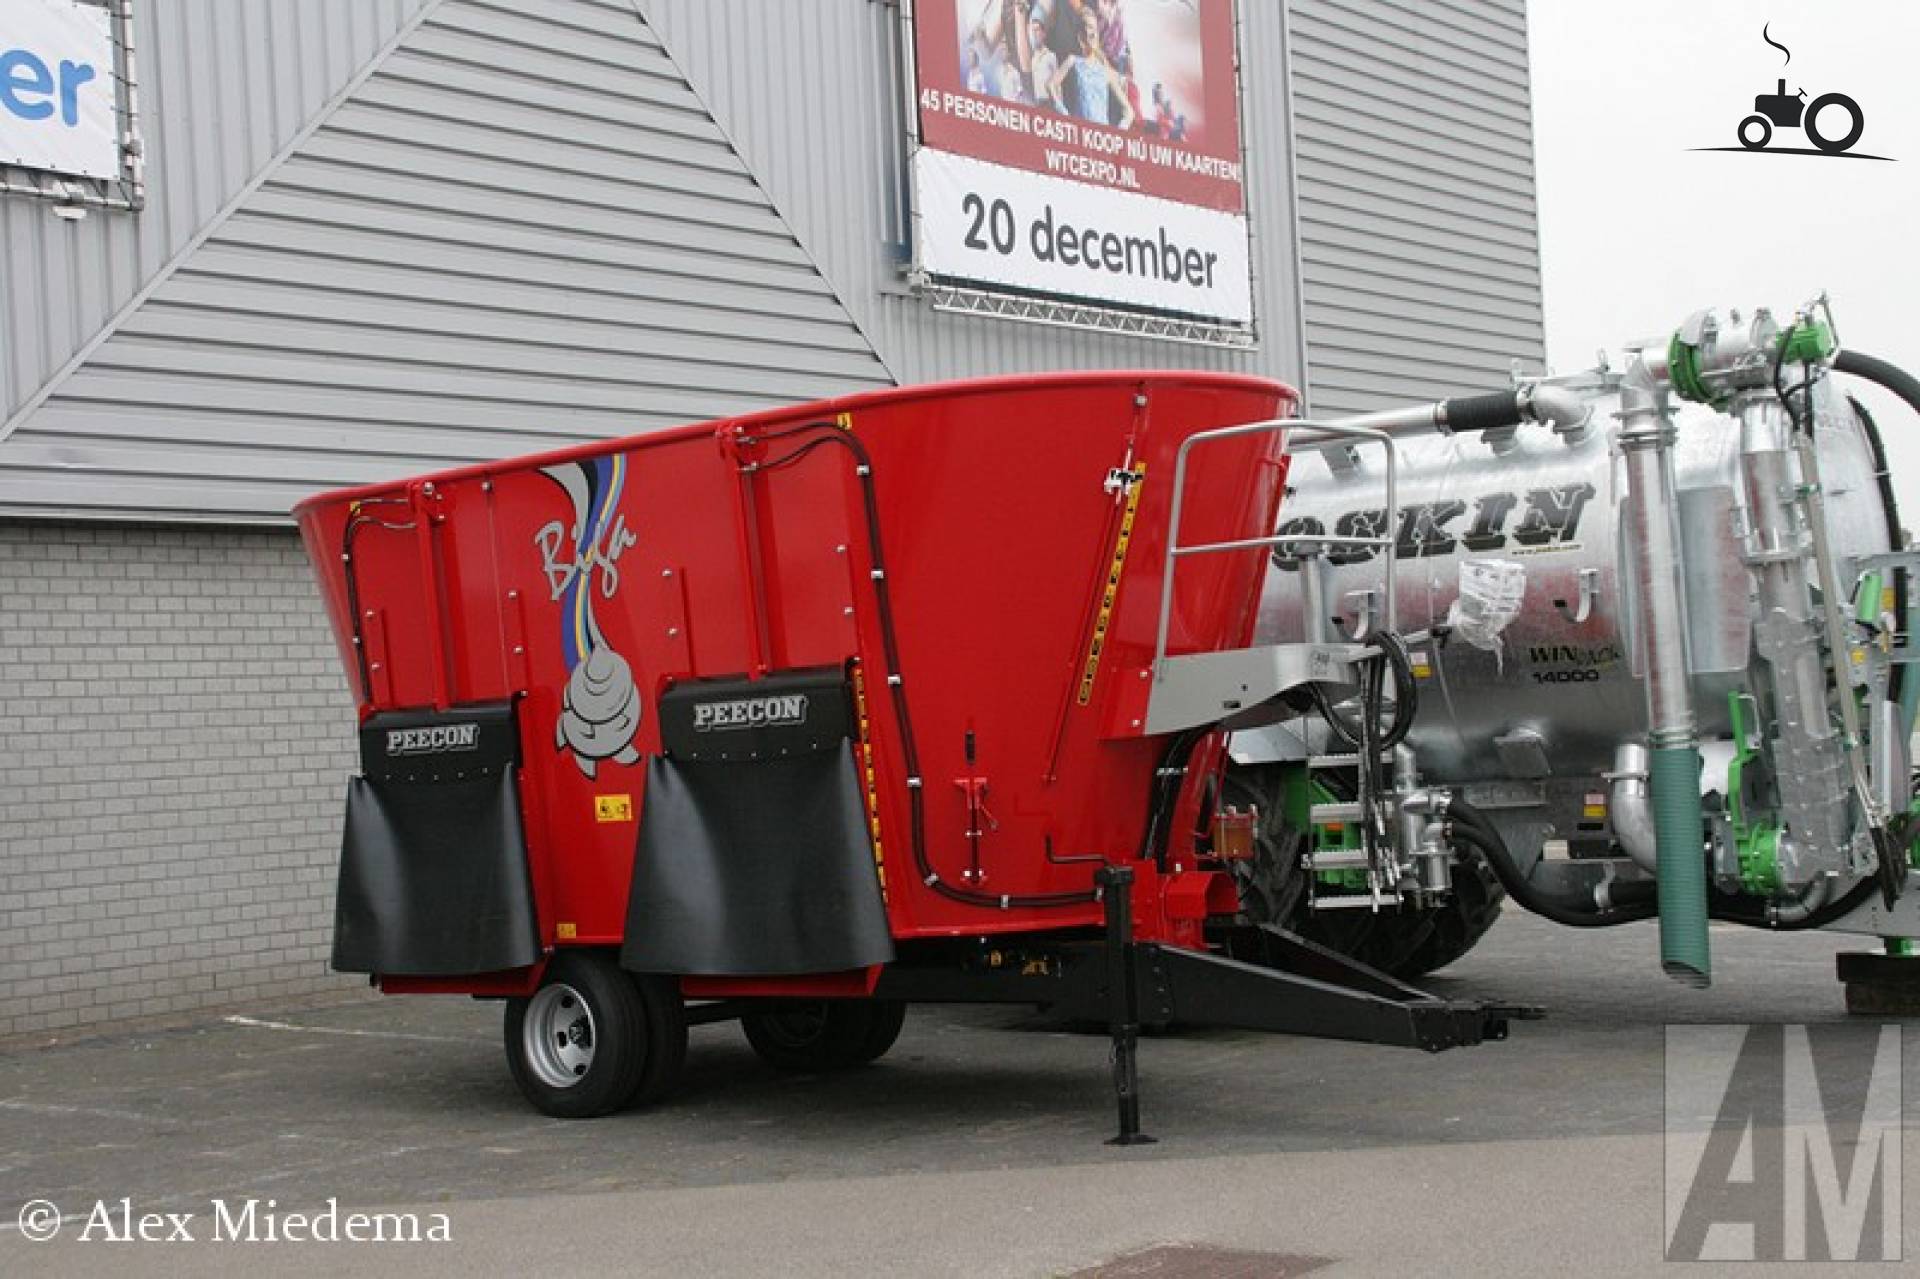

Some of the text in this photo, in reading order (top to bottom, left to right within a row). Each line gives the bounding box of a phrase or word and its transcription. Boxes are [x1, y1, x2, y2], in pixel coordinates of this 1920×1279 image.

[0, 49, 96, 127] er
[921, 88, 940, 112] 45
[943, 92, 1031, 133] PERSONEN
[1081, 127, 1124, 155] KOOP
[1150, 144, 1172, 167] UW
[1045, 149, 1141, 189] WTCEXPO.NL
[962, 192, 1218, 289] 20 december
[386, 723, 479, 756] PEECON
[693, 694, 807, 732] PEECON
